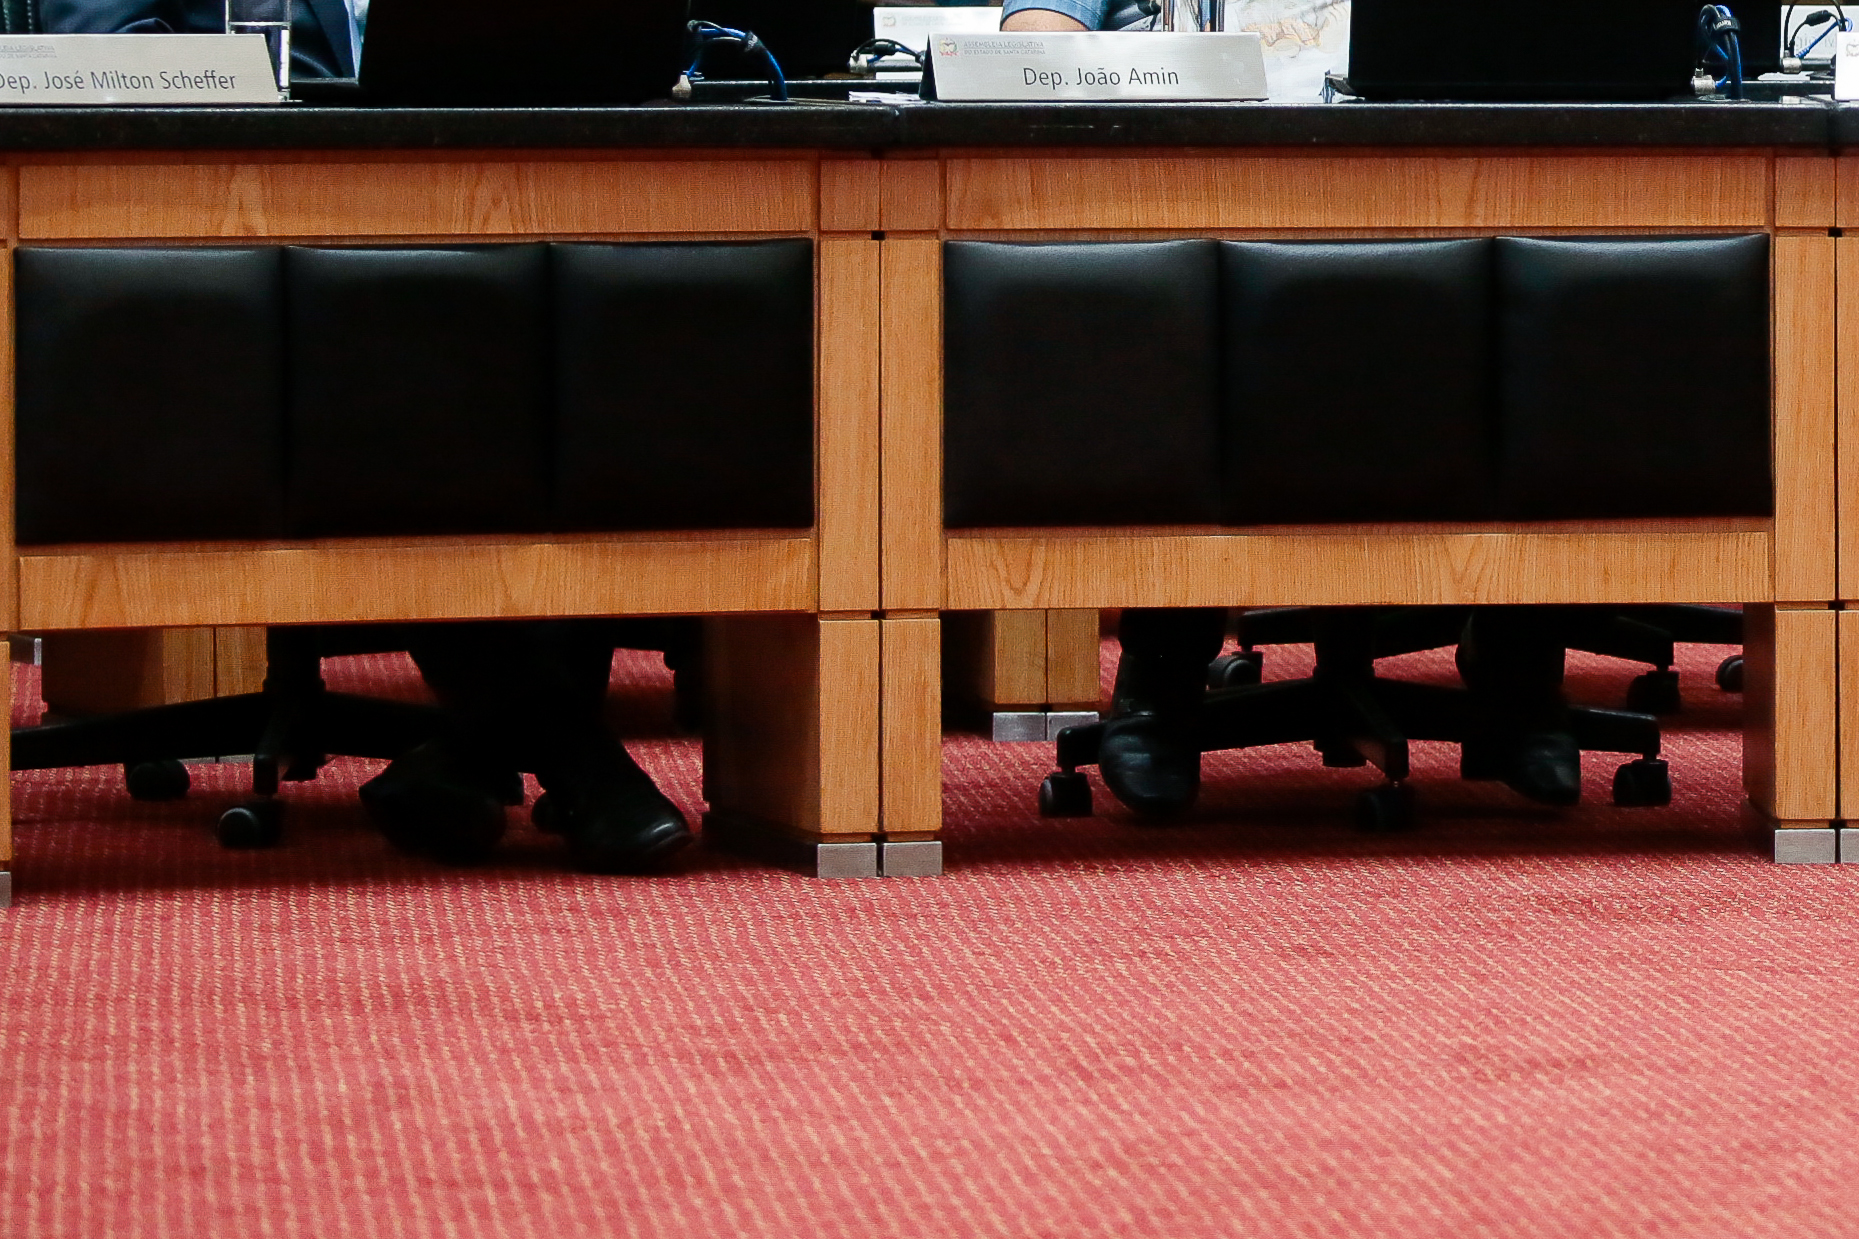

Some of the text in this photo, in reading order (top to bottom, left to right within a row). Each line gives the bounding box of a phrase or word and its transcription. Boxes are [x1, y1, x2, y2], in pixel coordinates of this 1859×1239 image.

[44, 70, 85, 90] José
[91, 70, 155, 90] Milton
[159, 70, 236, 90] Scheffer
[1023, 67, 1179, 90] Dep. João Amin
